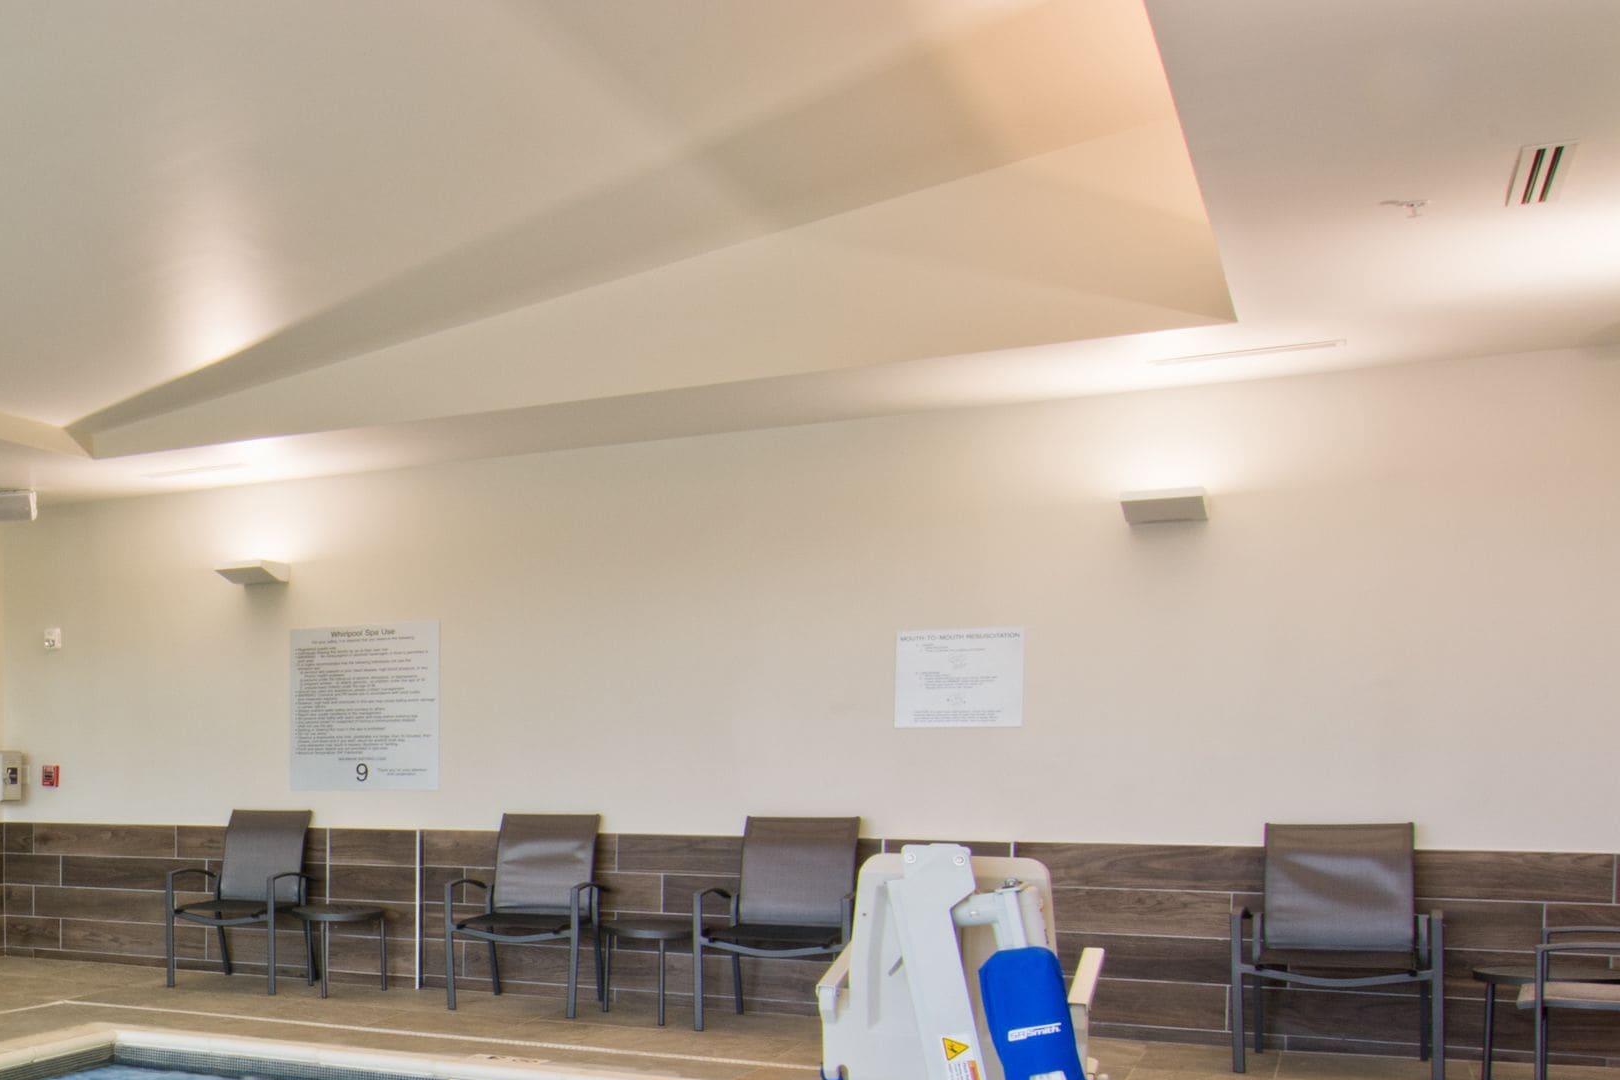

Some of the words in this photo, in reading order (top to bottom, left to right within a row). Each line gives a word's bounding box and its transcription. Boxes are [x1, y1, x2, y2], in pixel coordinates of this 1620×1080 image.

[330, 629, 363, 638] Whirlpool
[365, 628, 379, 637] Spa
[356, 763, 369, 782] 9
